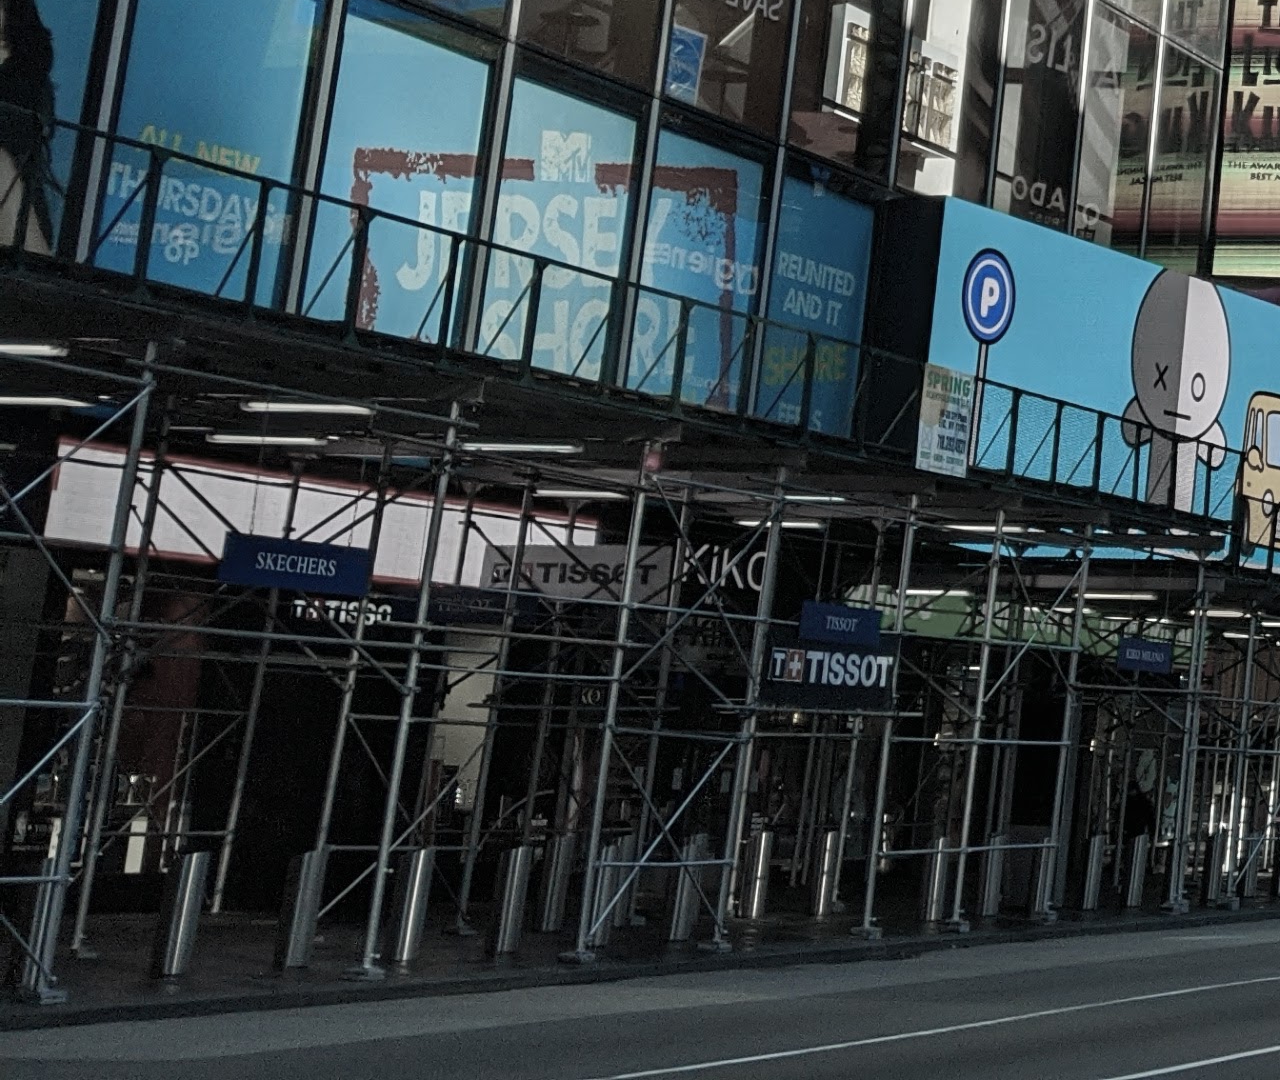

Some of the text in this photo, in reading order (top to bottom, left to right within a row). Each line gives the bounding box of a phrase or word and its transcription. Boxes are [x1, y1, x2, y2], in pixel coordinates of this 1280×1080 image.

[196, 140, 262, 181] NEW
[1227, 160, 1248, 170] THE
[1250, 172, 1272, 181] BEST
[396, 190, 673, 291] JERSEY
[777, 251, 855, 297] REUNITED
[783, 287, 844, 327] AND IT
[481, 298, 695, 382] SHORE
[926, 370, 971, 398] SPRING
[255, 550, 338, 578] SKECHERS
[825, 616, 858, 633] TISSOT
[805, 650, 894, 688] TISSOT
